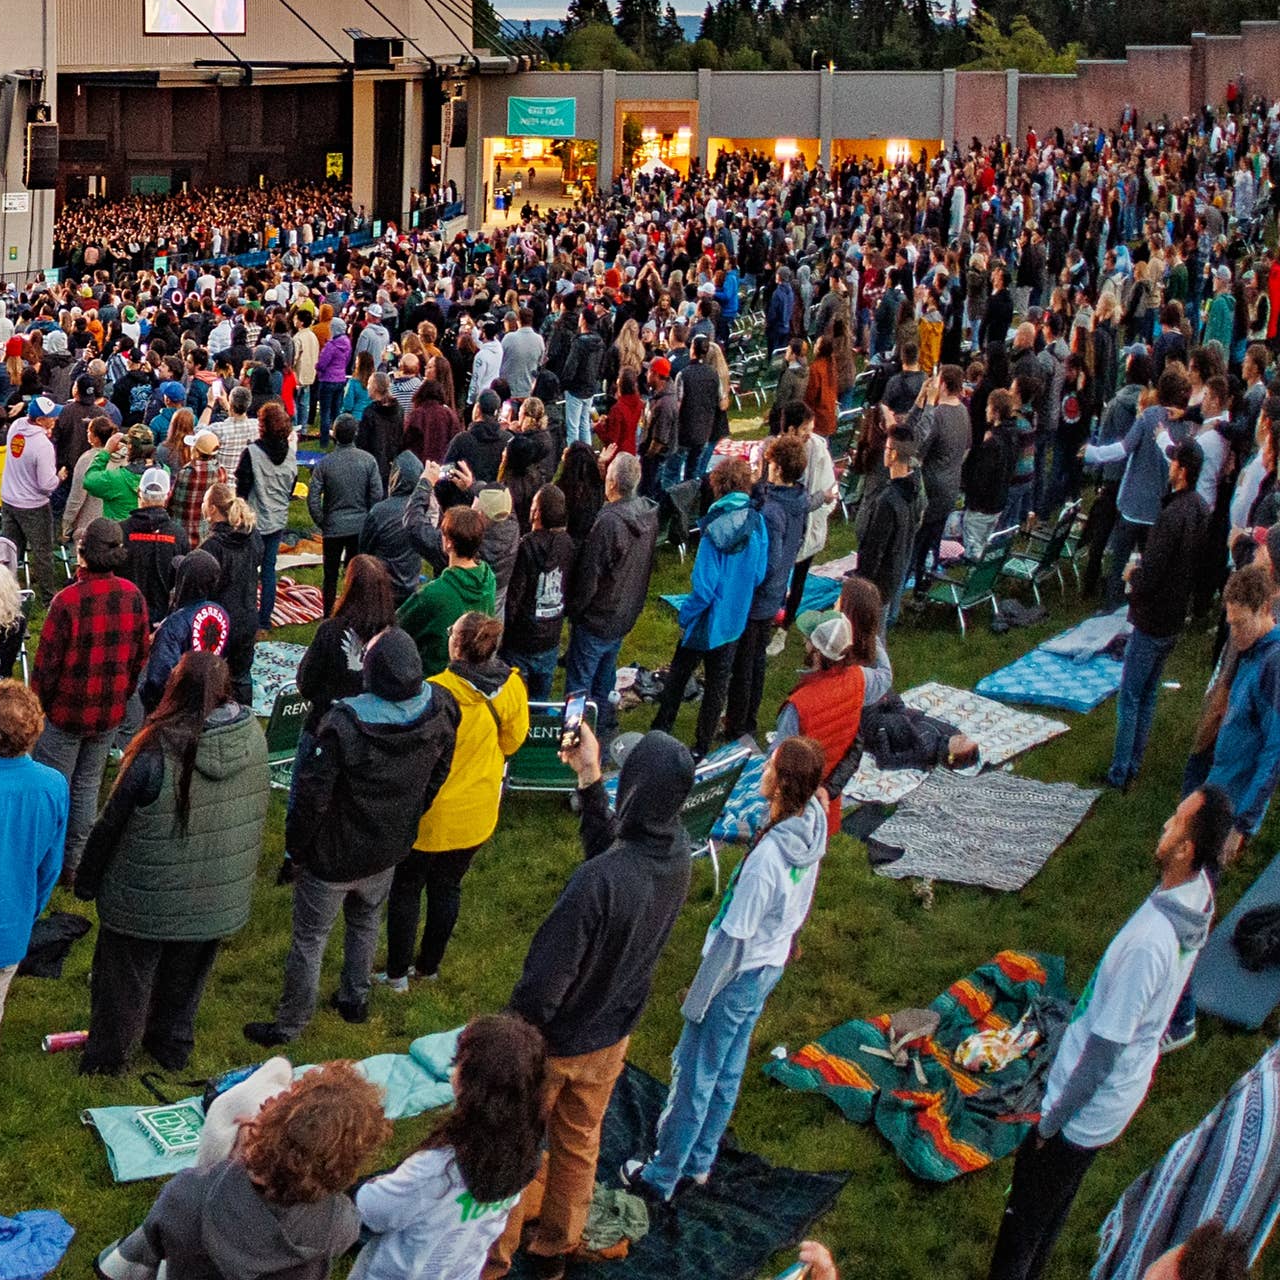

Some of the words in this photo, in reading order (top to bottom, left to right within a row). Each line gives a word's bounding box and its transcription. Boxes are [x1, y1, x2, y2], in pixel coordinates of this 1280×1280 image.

[527, 106, 544, 115] EXIT
[545, 106, 556, 115] TO
[540, 117, 565, 127] PLAZA
